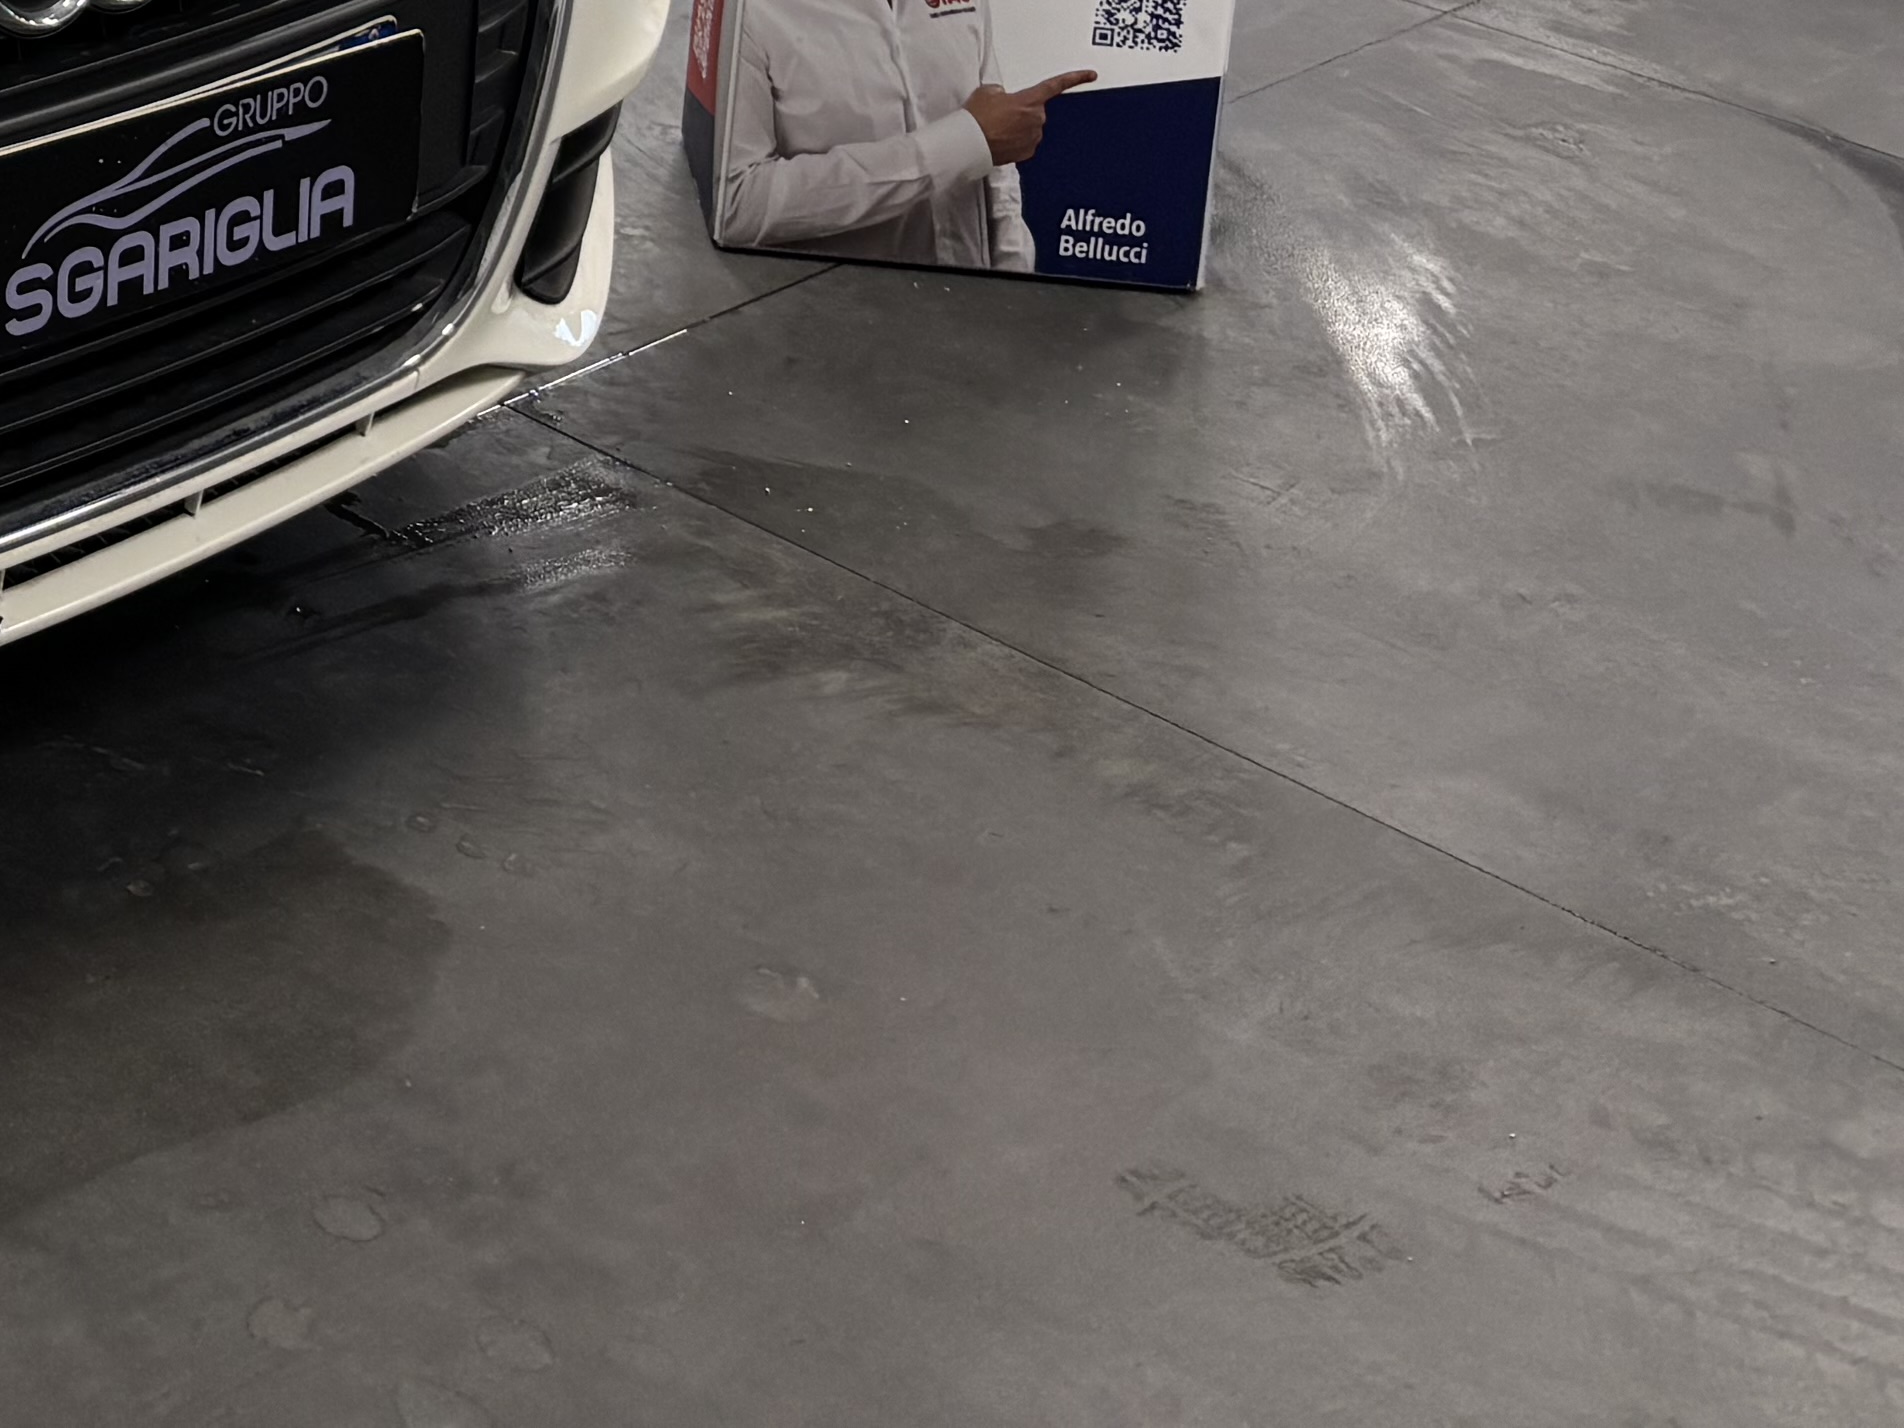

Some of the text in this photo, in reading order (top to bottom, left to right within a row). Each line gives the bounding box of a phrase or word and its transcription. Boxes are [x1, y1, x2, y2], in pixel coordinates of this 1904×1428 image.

[213, 75, 328, 137] GRUPPO
[1060, 208, 1146, 237] Alfredo
[5, 165, 356, 336] SGARIGLIA
[1057, 235, 1148, 264] Bellucci
